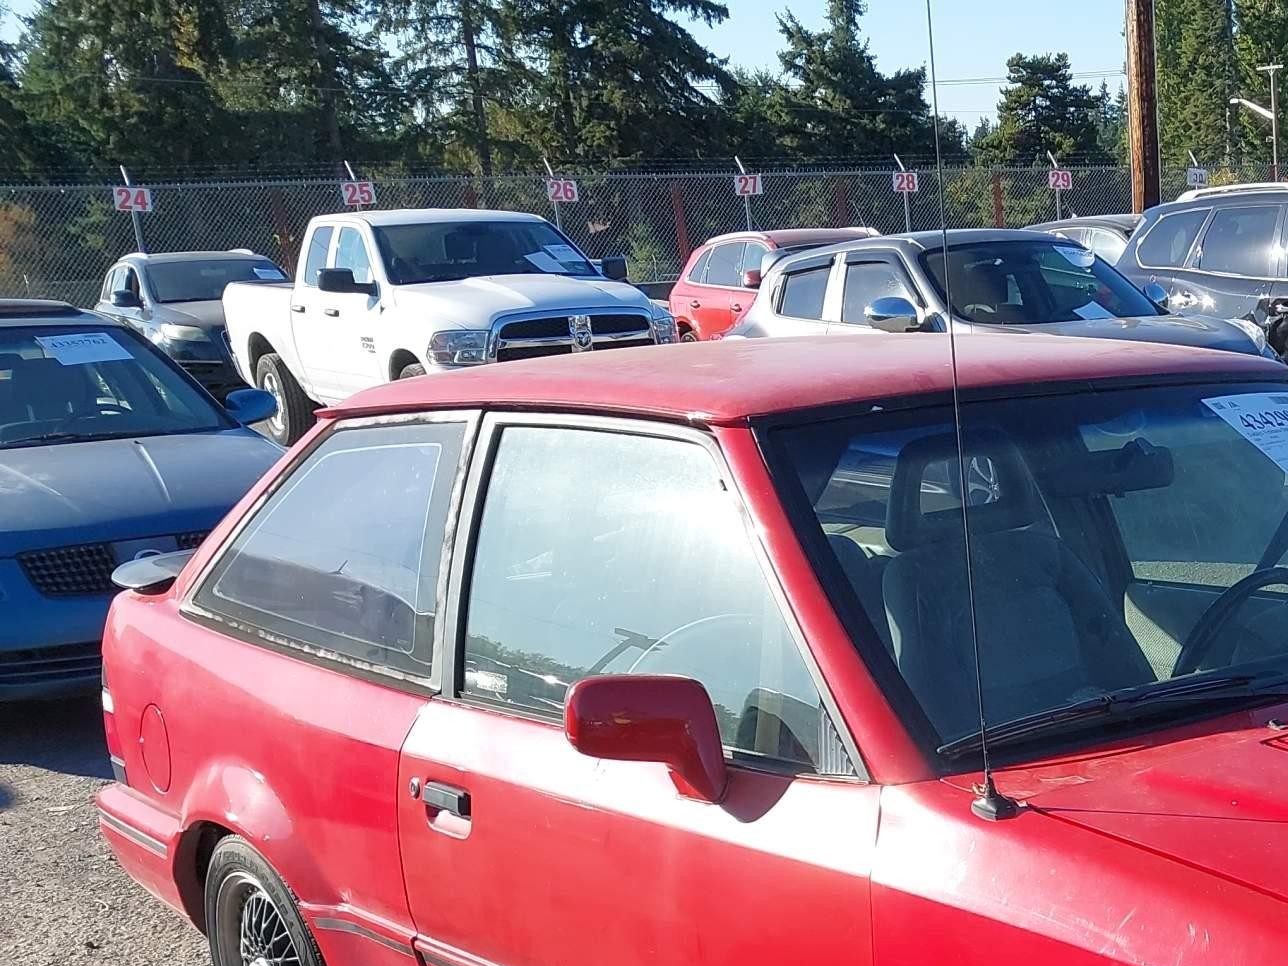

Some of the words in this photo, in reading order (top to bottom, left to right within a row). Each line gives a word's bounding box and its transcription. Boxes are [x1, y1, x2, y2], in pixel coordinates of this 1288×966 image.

[738, 175, 757, 194] 27
[895, 173, 916, 191] 28
[1051, 171, 1070, 188] 29
[116, 188, 149, 210] 24
[344, 183, 373, 205] 25
[550, 181, 576, 200] 26
